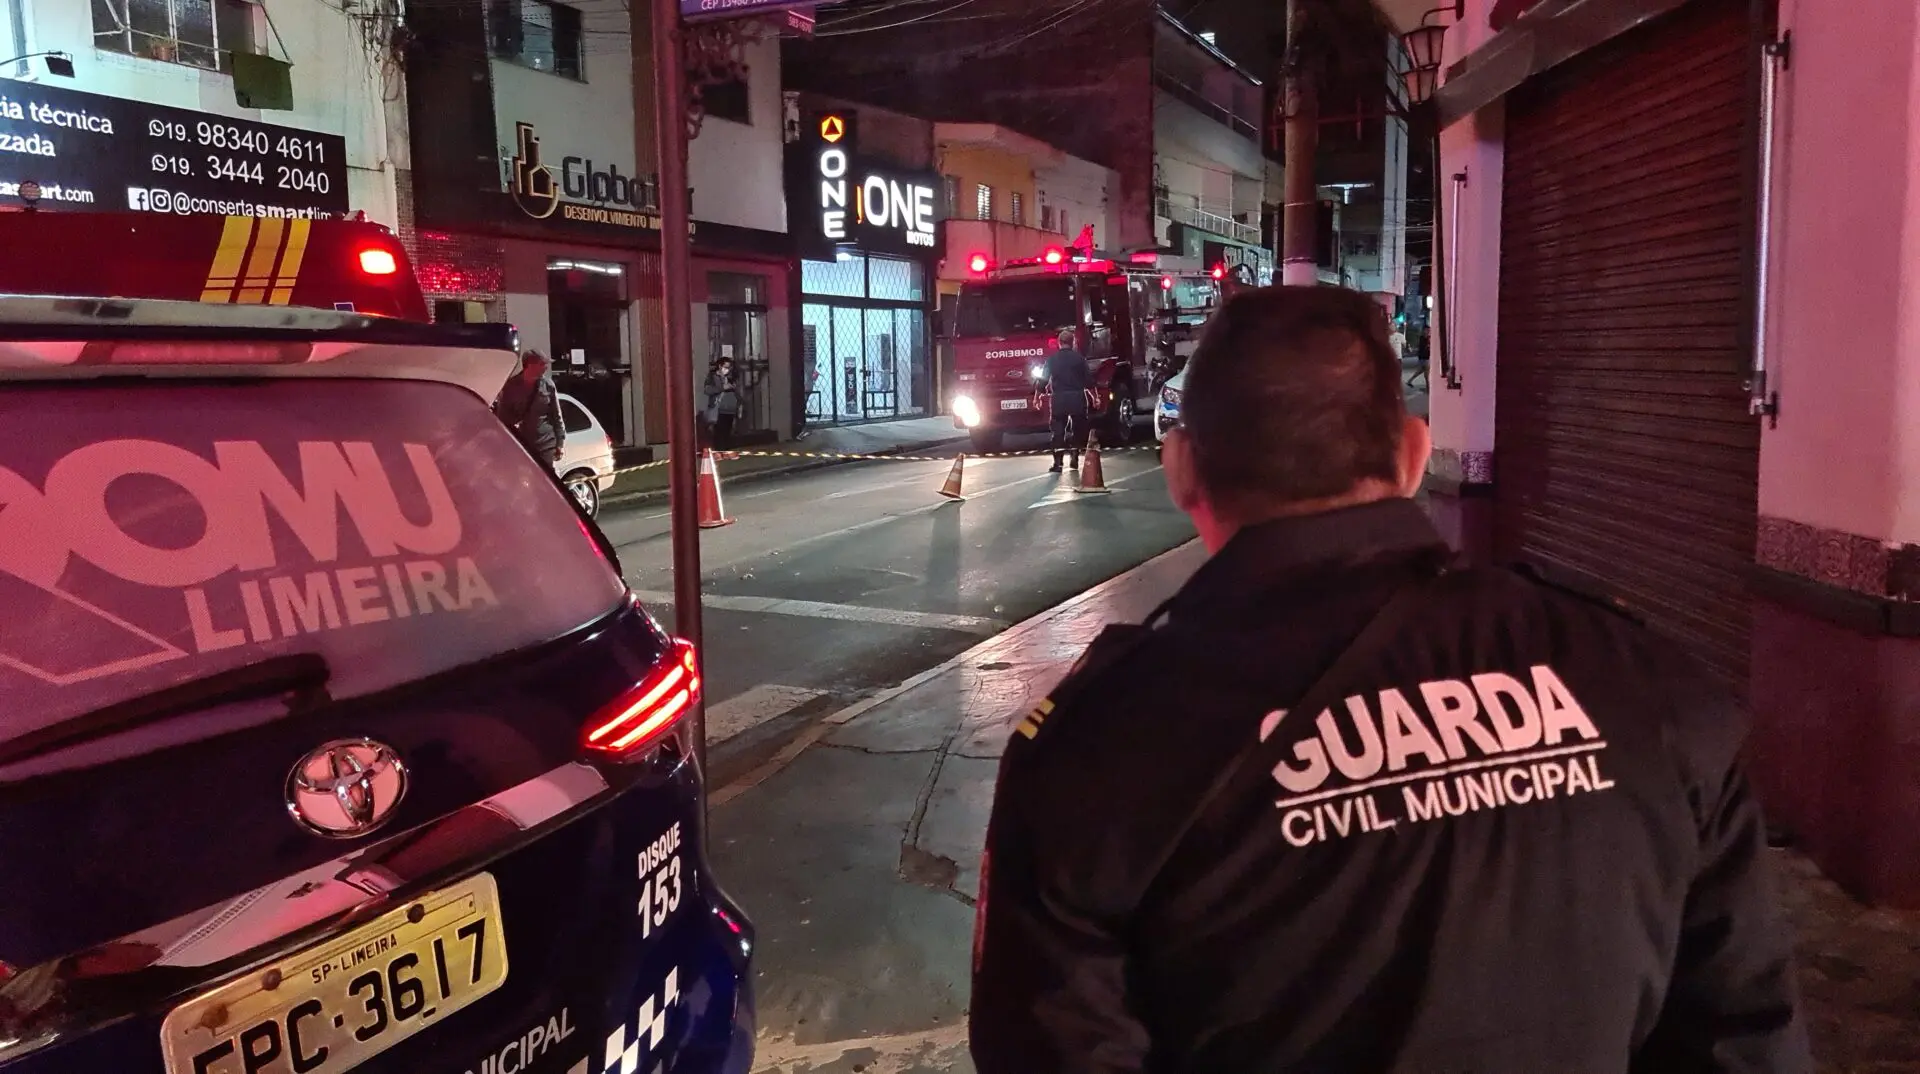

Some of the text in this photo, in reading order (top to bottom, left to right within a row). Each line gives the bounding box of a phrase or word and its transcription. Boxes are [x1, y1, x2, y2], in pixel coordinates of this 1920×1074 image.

[701, 0, 719, 10] CEP
[29, 101, 114, 134] técnica
[197, 121, 269, 154] 98340
[276, 136, 324, 163] 4611
[207, 155, 265, 185] 3444
[277, 166, 329, 194] 2040
[820, 149, 846, 238] ONE
[564, 205, 647, 229] DESENVOLVIMENTO
[863, 175, 934, 234] ONE
[906, 230, 935, 247] MOTOS
[184, 556, 497, 652] LIMEIRA
[1259, 665, 1600, 792] GUARDA
[1281, 755, 1615, 848] CIVIL MUNICIPAL
[638, 820, 681, 880] DISQUE
[638, 855, 681, 940] 153
[311, 933, 398, 984] SP-LIMEIRA
